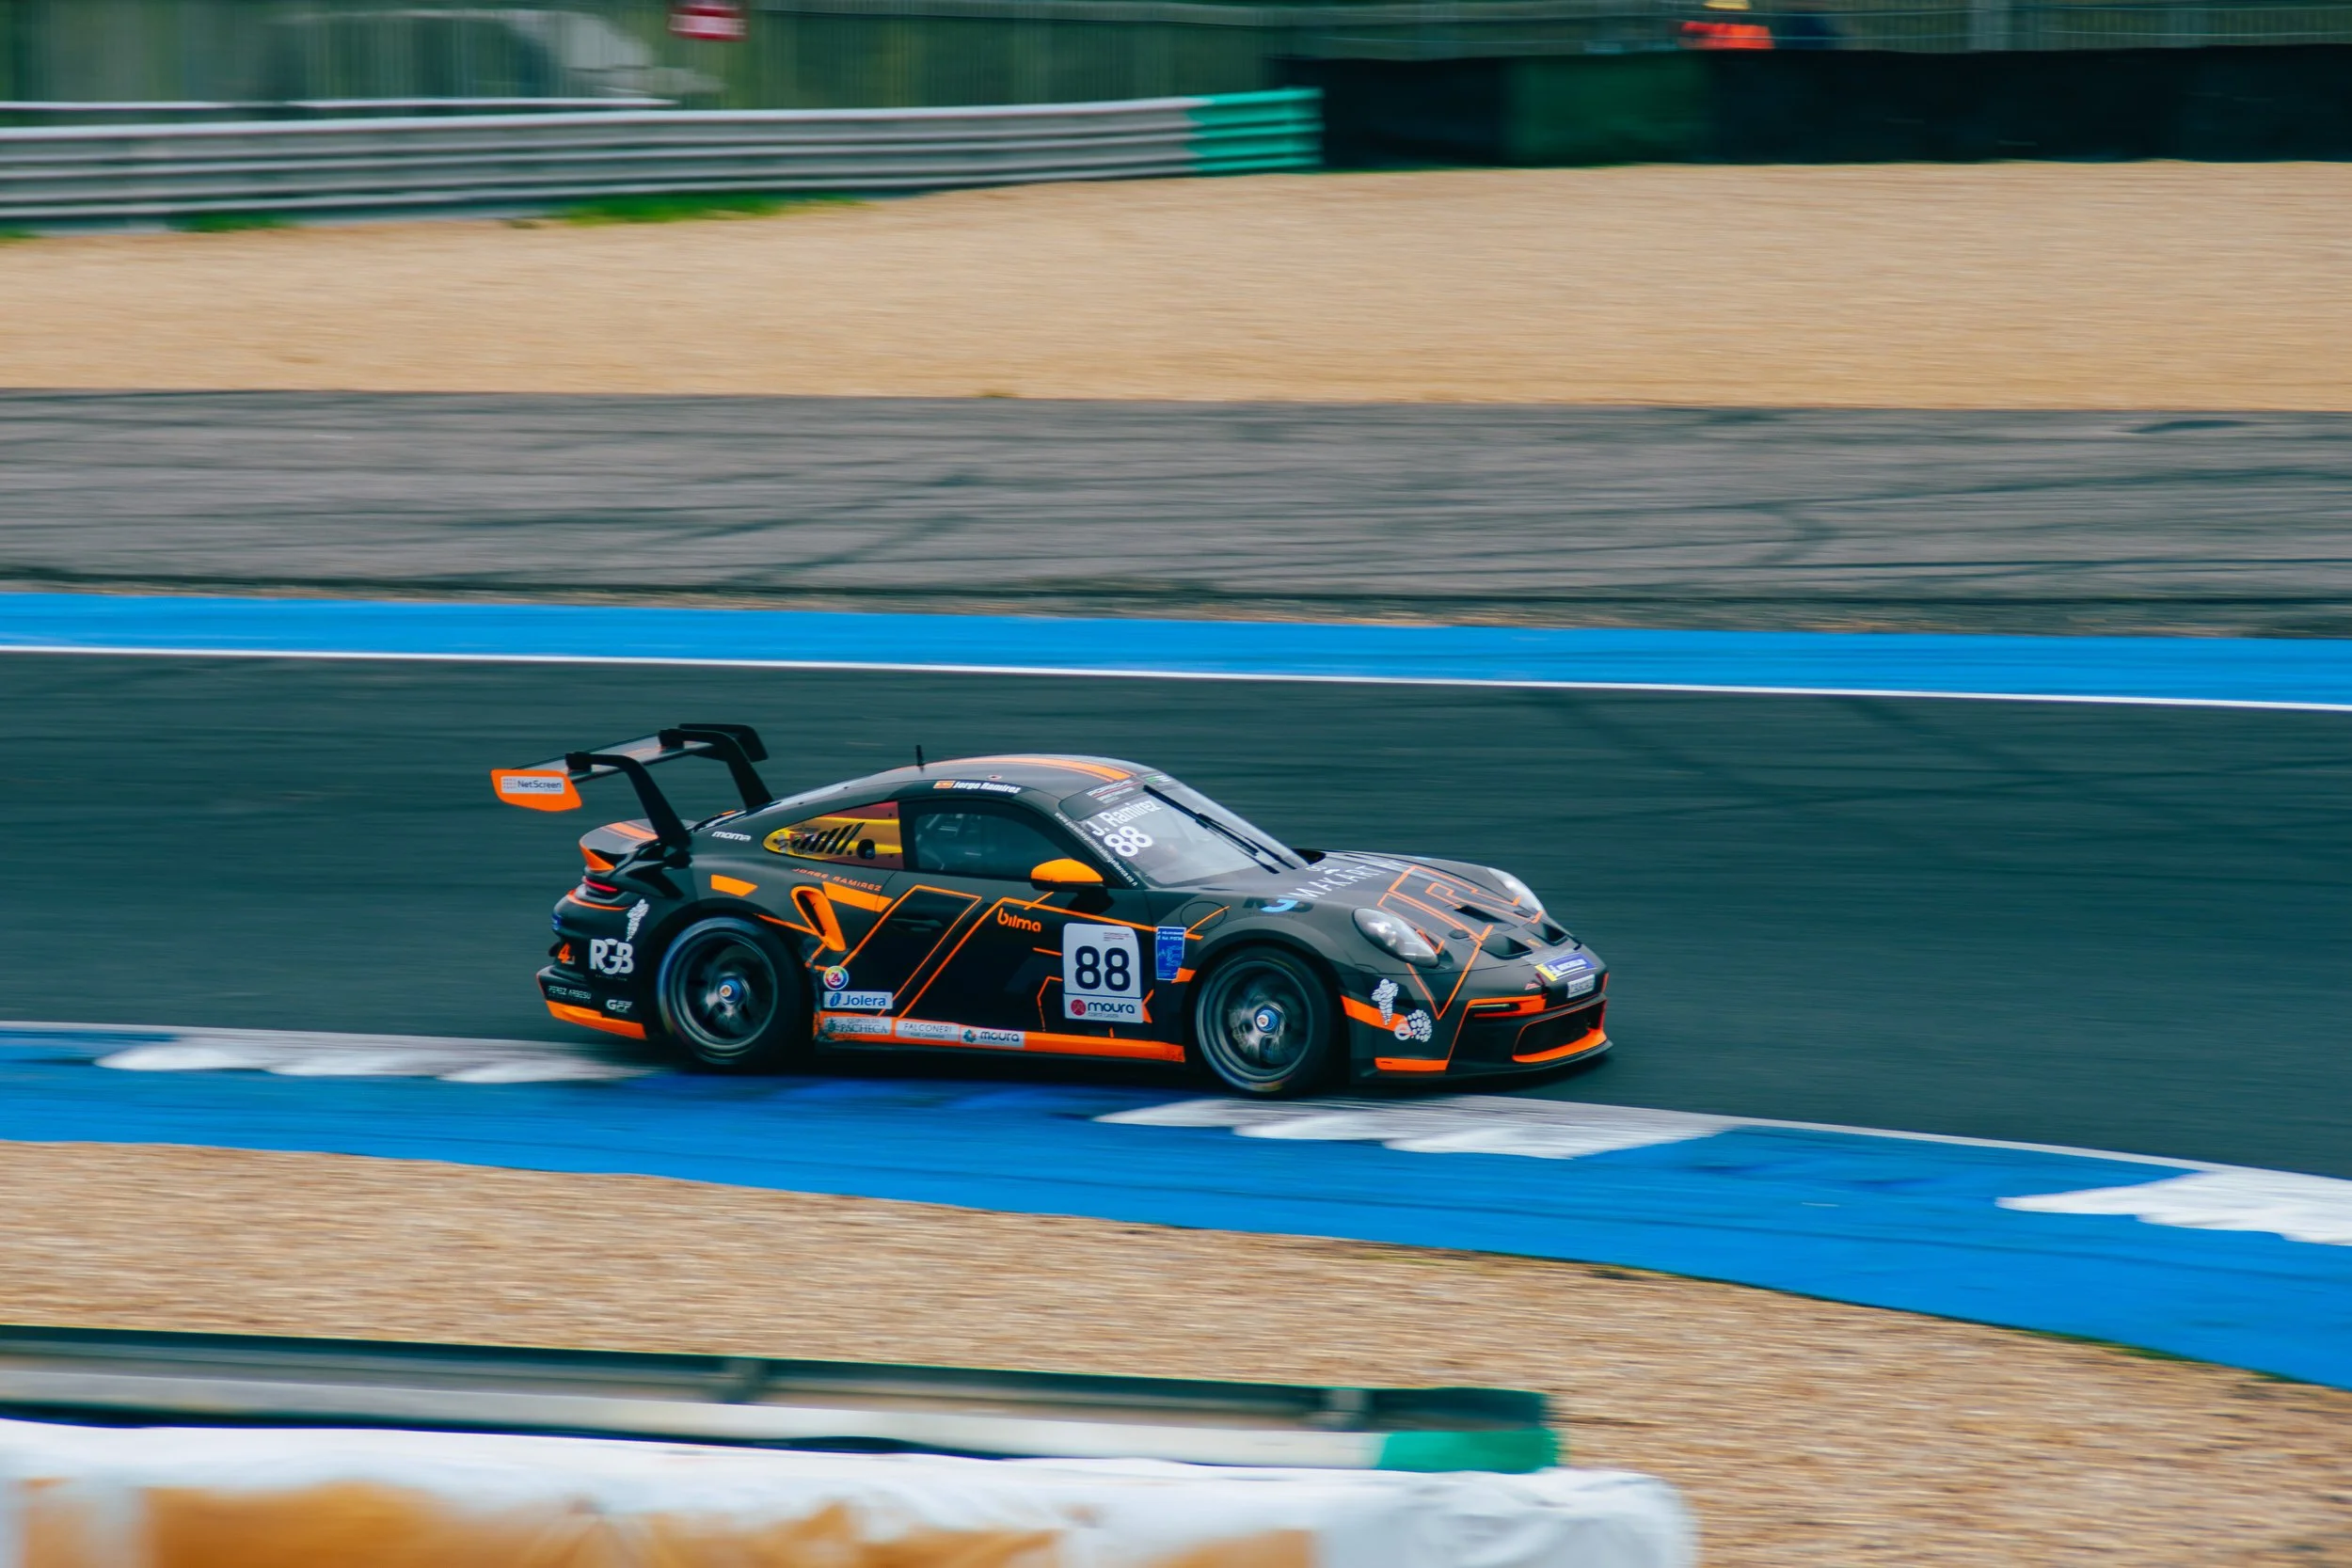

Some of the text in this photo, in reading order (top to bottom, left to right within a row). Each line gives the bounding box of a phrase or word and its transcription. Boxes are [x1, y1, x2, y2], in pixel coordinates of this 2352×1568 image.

[1087, 820, 1110, 836] J.
[1104, 825, 1153, 857] 88
[791, 867, 882, 892] JORGE RAMIREZ
[589, 938, 634, 974] RGB
[1075, 945, 1131, 992] 88
[843, 994, 886, 1006] Jolera
[1088, 1002, 1135, 1014] moura
[980, 1031, 1020, 1042] moura
